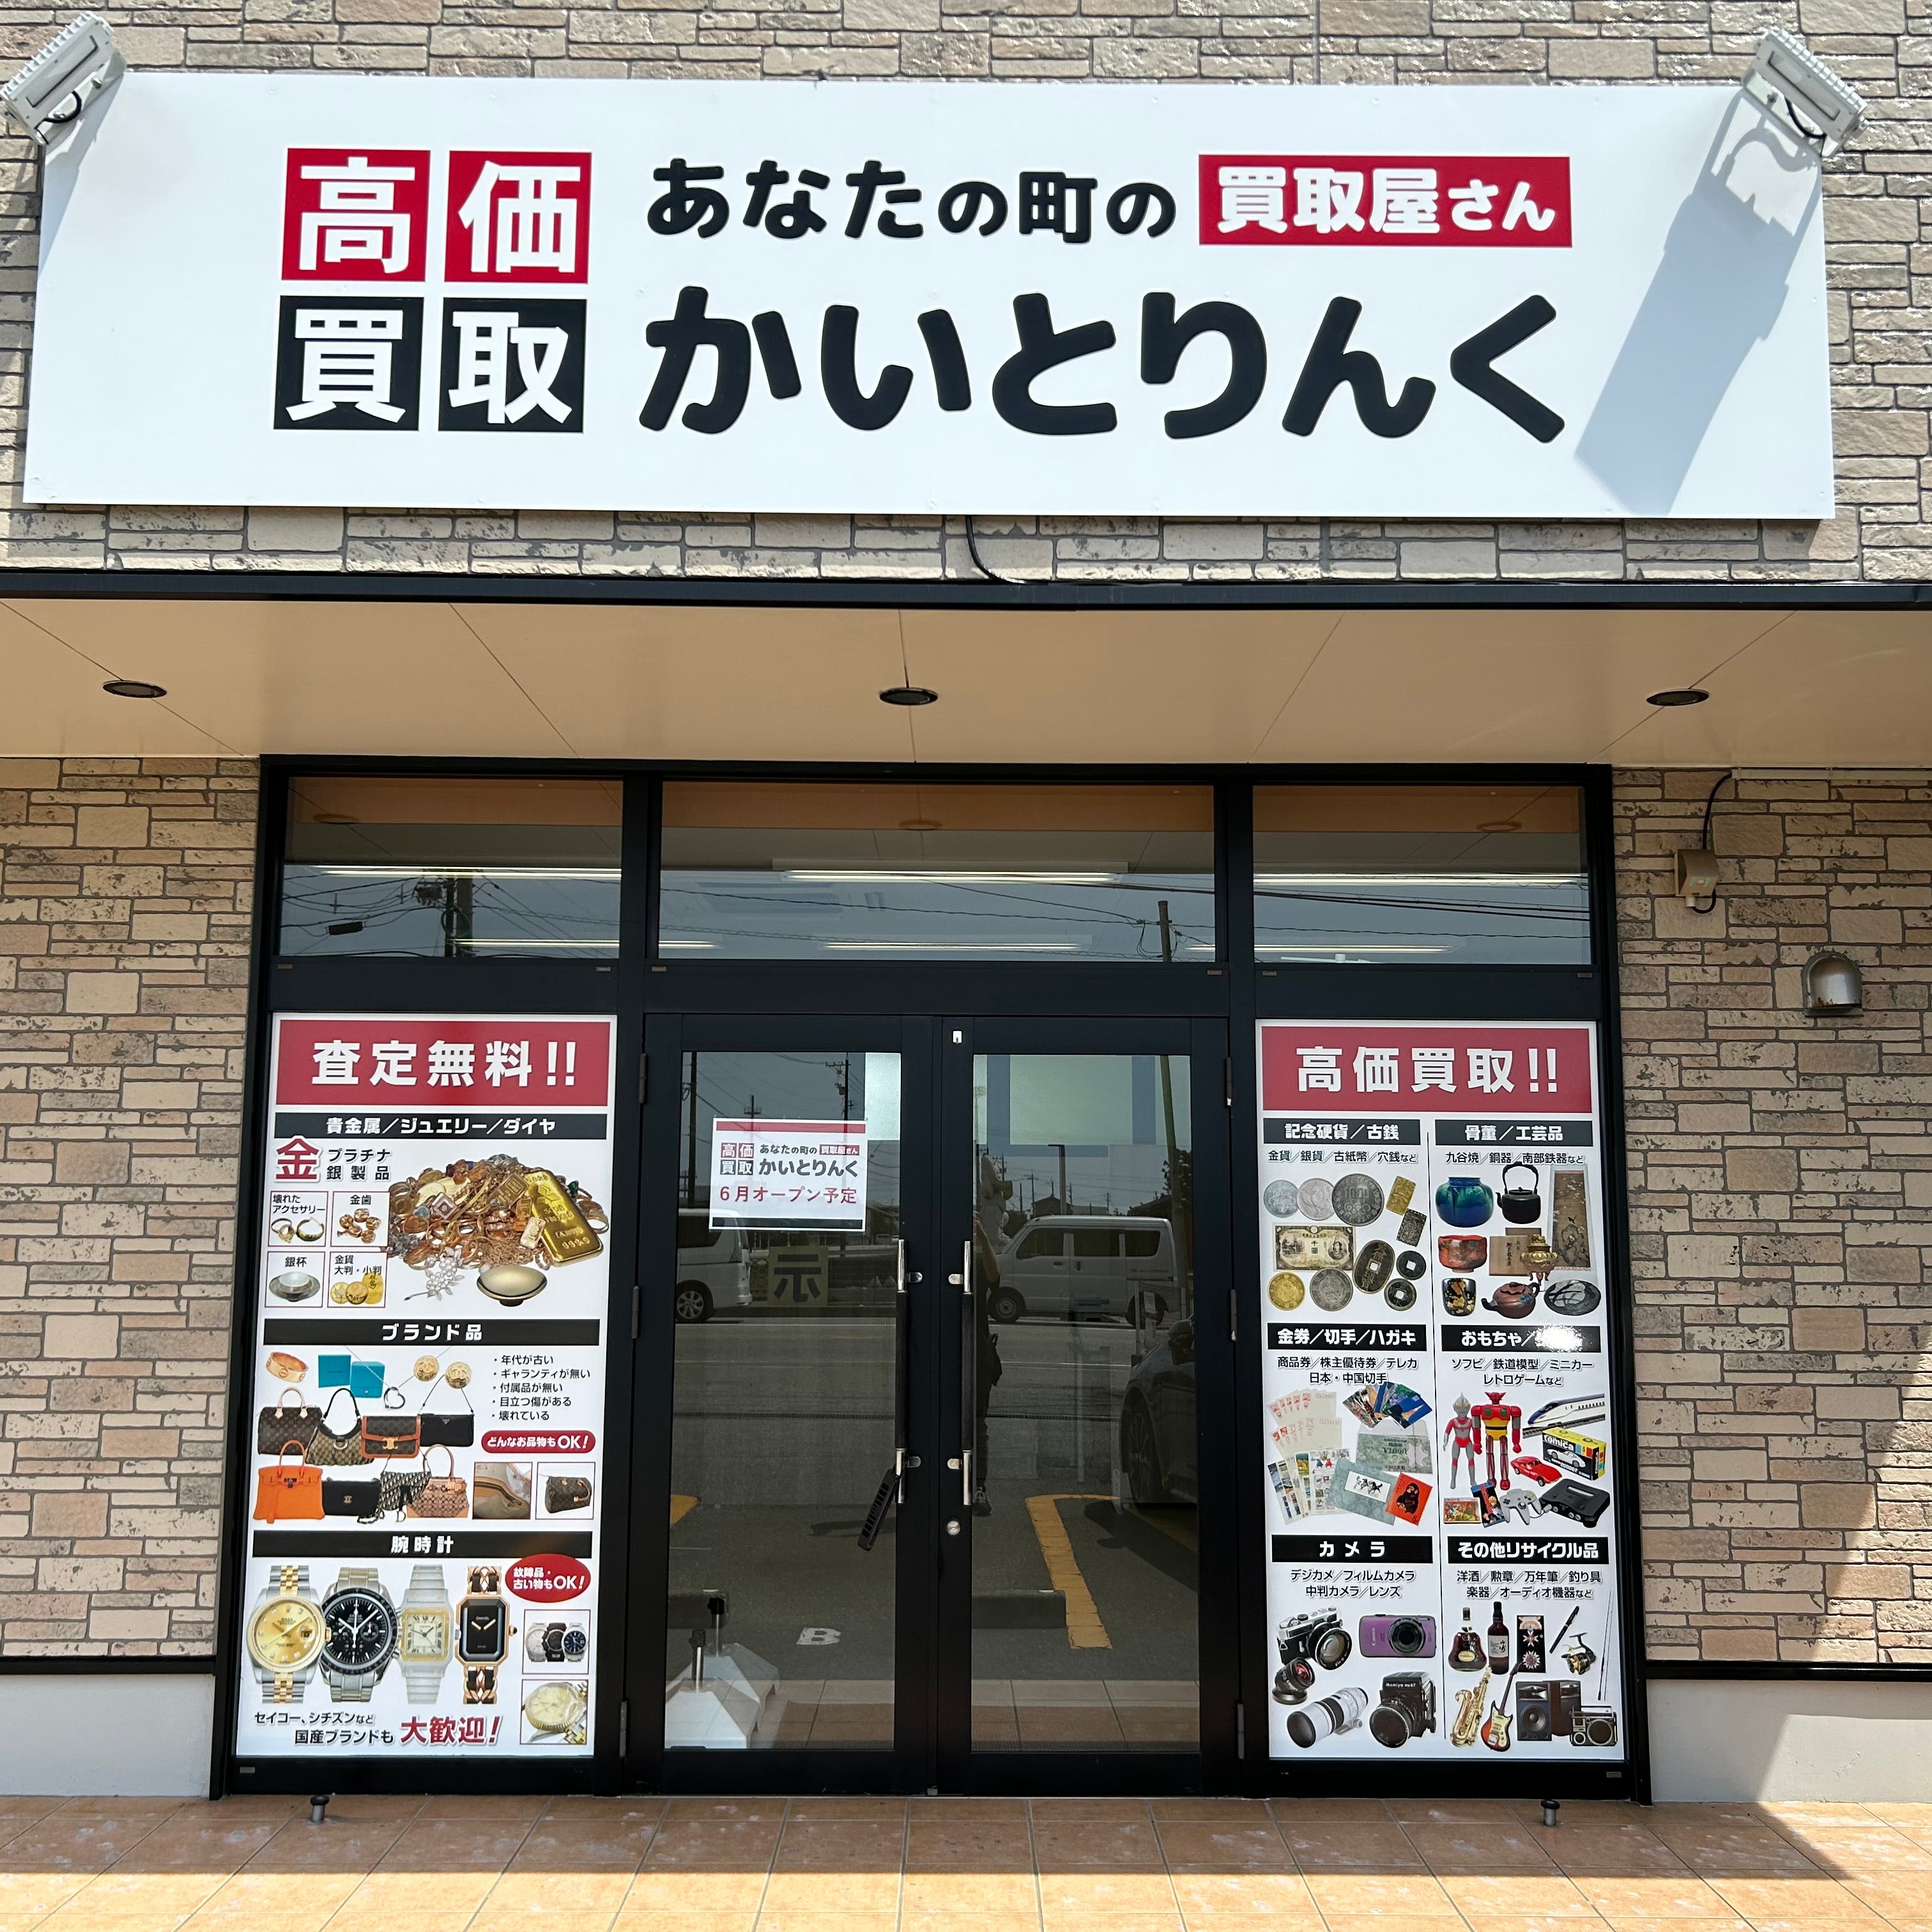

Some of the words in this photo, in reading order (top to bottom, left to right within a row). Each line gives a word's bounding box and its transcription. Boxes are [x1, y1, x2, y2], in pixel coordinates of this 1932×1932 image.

[647, 158, 1176, 243] あなたの町の
[1216, 167, 1556, 234] 買取屋さん
[299, 157, 581, 273] 高価
[286, 309, 572, 424] 買取
[639, 286, 1565, 443] かいとりんく
[328, 1149, 390, 1162] プラチナ
[722, 1144, 753, 1158] 高価
[760, 1144, 817, 1154] あなたの町の
[821, 1146, 858, 1154] 買取屋さん
[276, 1138, 319, 1180] 金
[326, 1165, 390, 1181] 銀製品
[721, 1161, 753, 1174] 買取
[759, 1158, 857, 1177] かいとりんく
[273, 1194, 300, 1204] 壊れた
[350, 1195, 371, 1205] 金歯
[719, 1186, 857, 1204] 6月オープン予定
[273, 1206, 325, 1214] アクセサリー
[285, 1257, 307, 1268] 銀杯
[335, 1255, 354, 1264] 金貨
[334, 1266, 382, 1275] 大判・小判
[382, 1323, 482, 1341] ブランド品
[1484, 1374, 1562, 1386] レトロゲームなど
[391, 1535, 454, 1554] 腕時計
[1319, 1541, 1385, 1556] カメラ
[1458, 1542, 1598, 1559] その他リサイクル品
[295, 1729, 394, 1744] 国産ブランドも
